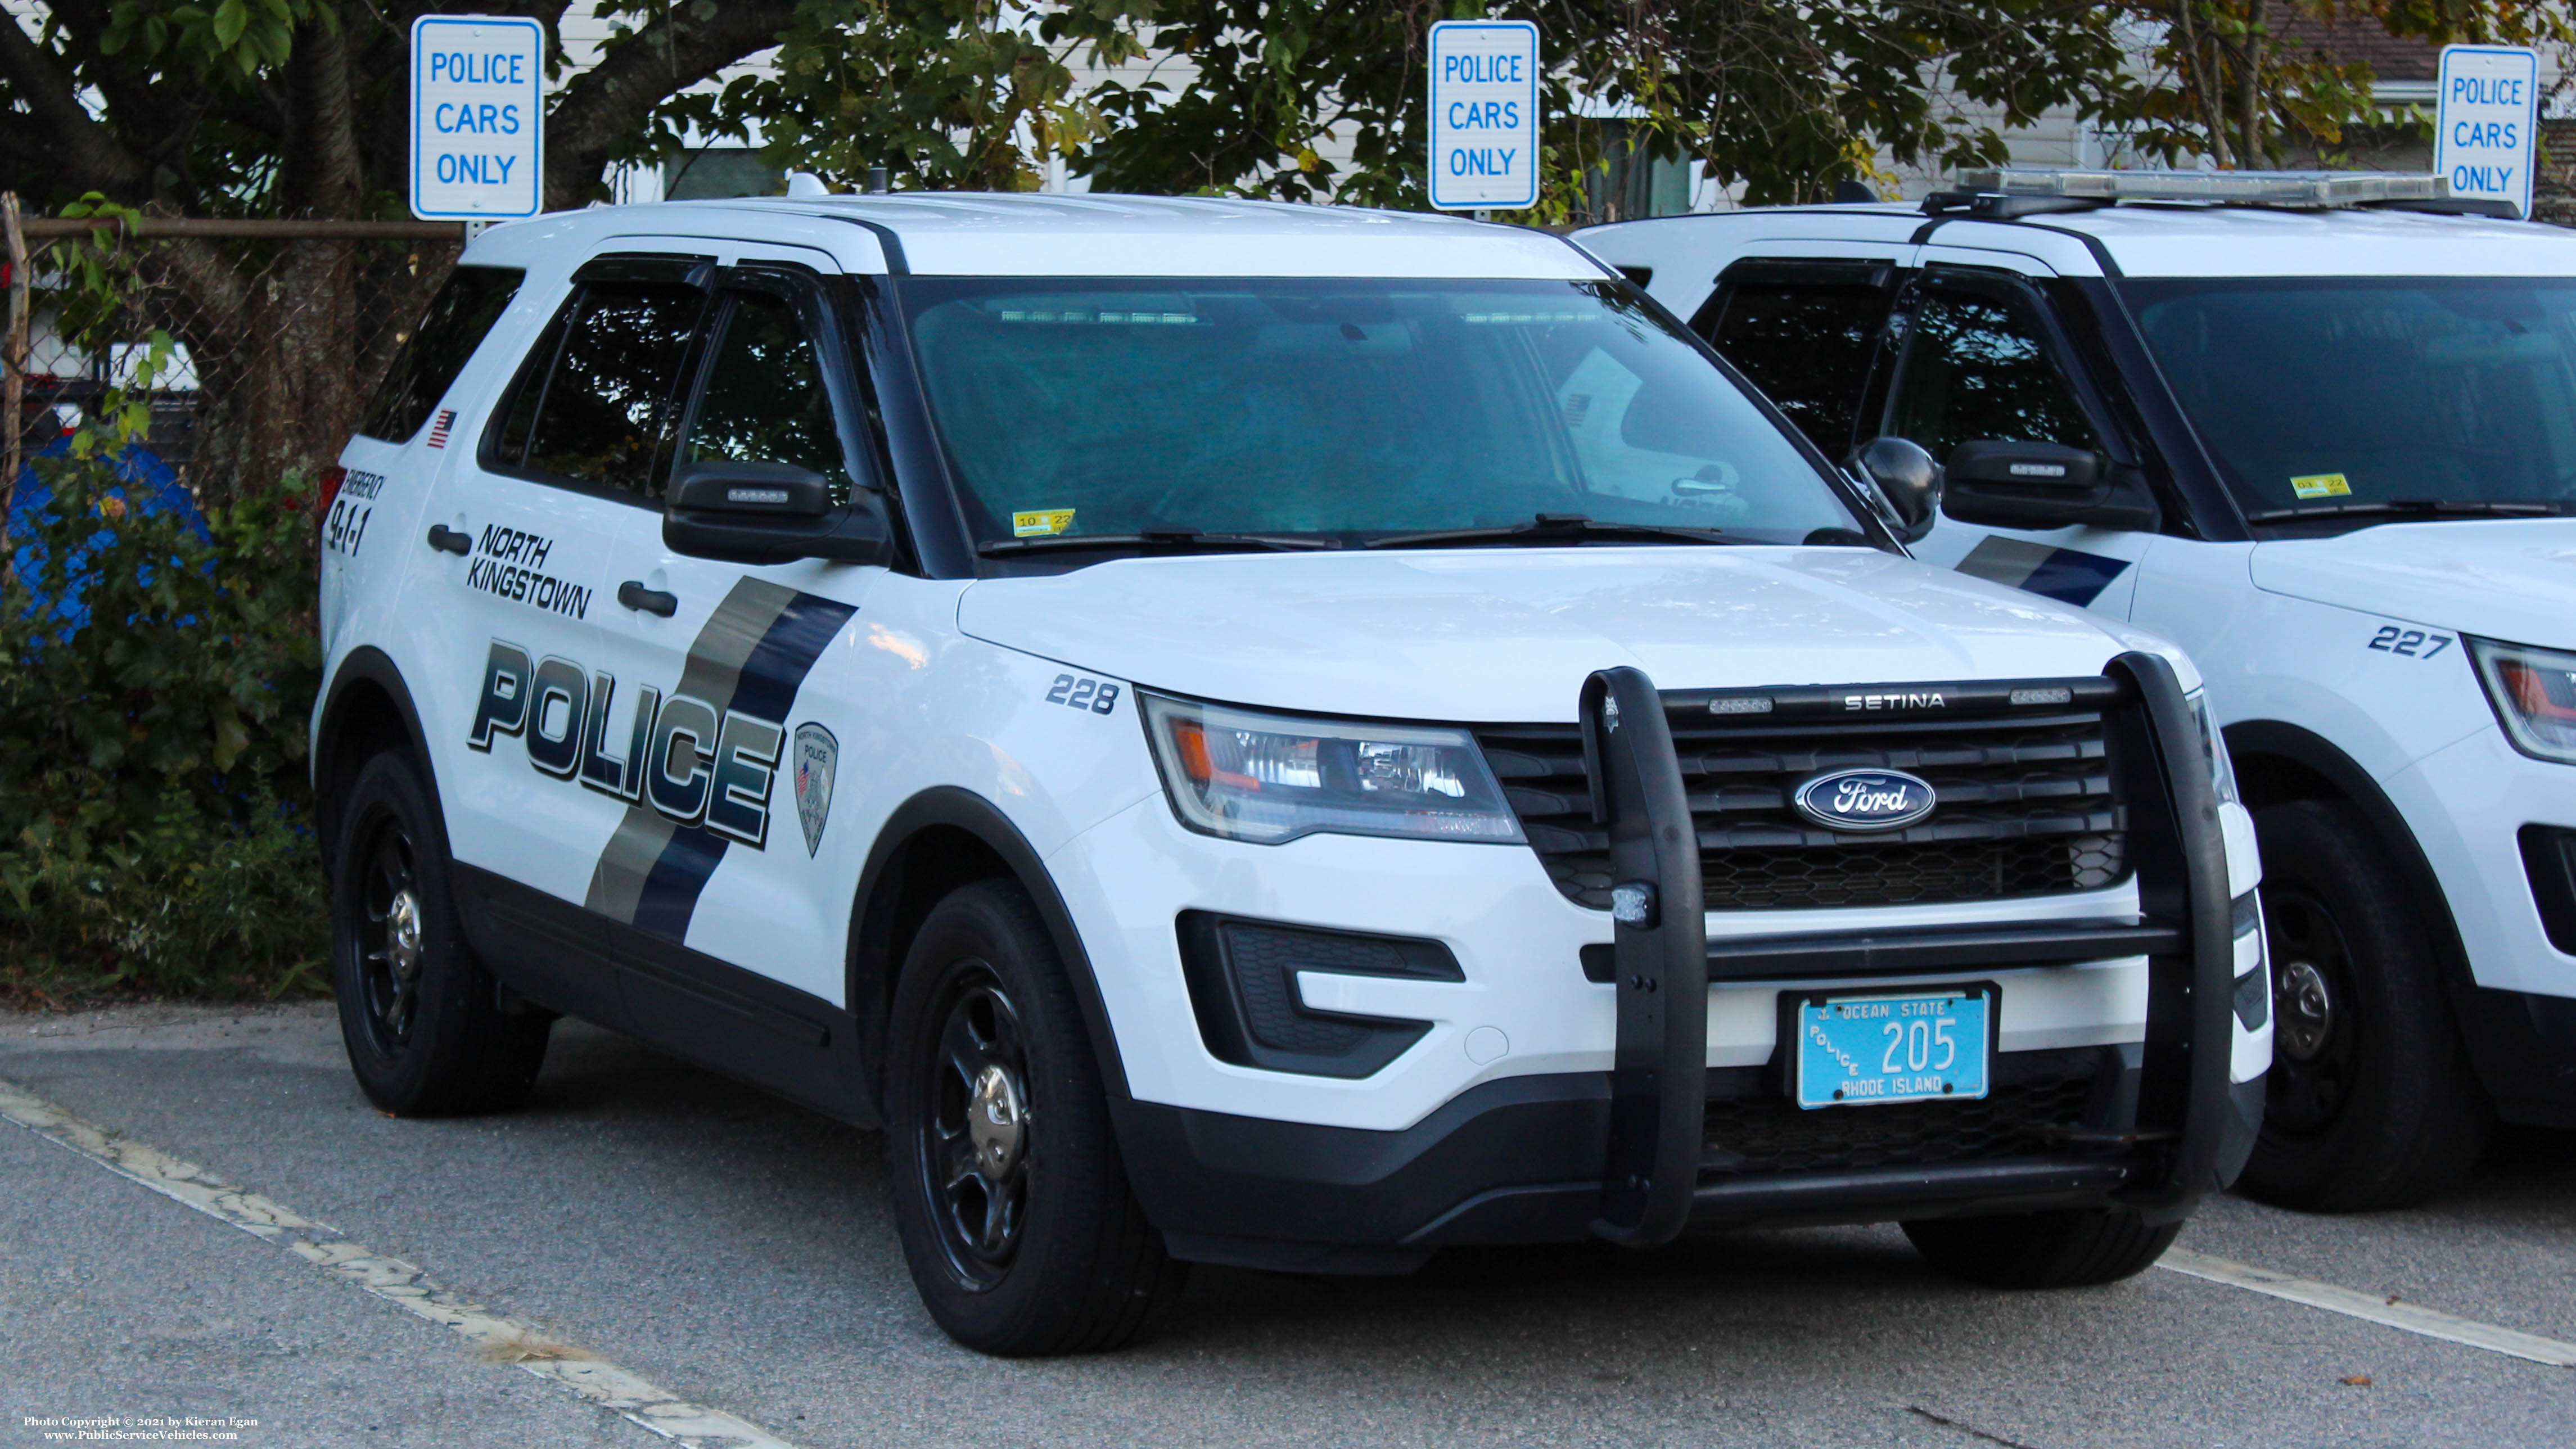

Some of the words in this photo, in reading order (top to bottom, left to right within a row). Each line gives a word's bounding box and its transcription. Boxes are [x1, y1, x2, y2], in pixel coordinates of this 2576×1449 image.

[431, 53, 524, 84] POLICE
[1446, 55, 1522, 83] POLICE
[2453, 78, 2523, 105] POLICE
[435, 103, 520, 134] CARS
[1449, 101, 1518, 130] CARS
[2455, 121, 2517, 148] CARS
[437, 153, 516, 184] ONLY
[1451, 148, 1516, 176] ONLY
[2453, 165, 2513, 192] ONLY
[342, 469, 387, 501] EMERGENCY
[328, 500, 372, 557] 9-1-1
[1020, 517, 1036, 526] 10
[1054, 515, 1071, 524] 22
[477, 523, 553, 569] NORTH
[467, 557, 592, 620] KINGSTOWN
[2368, 626, 2453, 660] 227
[1045, 673, 1120, 715] 228
[1844, 693, 1946, 710] SETINA
[466, 637, 787, 852] POLICE
[805, 744, 827, 763] POLICE
[1833, 778, 1909, 813] Ford
[1843, 1004, 1889, 1021] OCEAN
[1901, 1002, 1945, 1018] STATE
[1810, 1025, 1858, 1076] POLICE
[1882, 1018, 1956, 1075] 205
[1842, 1078, 1885, 1097] RHODE
[1893, 1076, 1942, 1094] ISLAND
